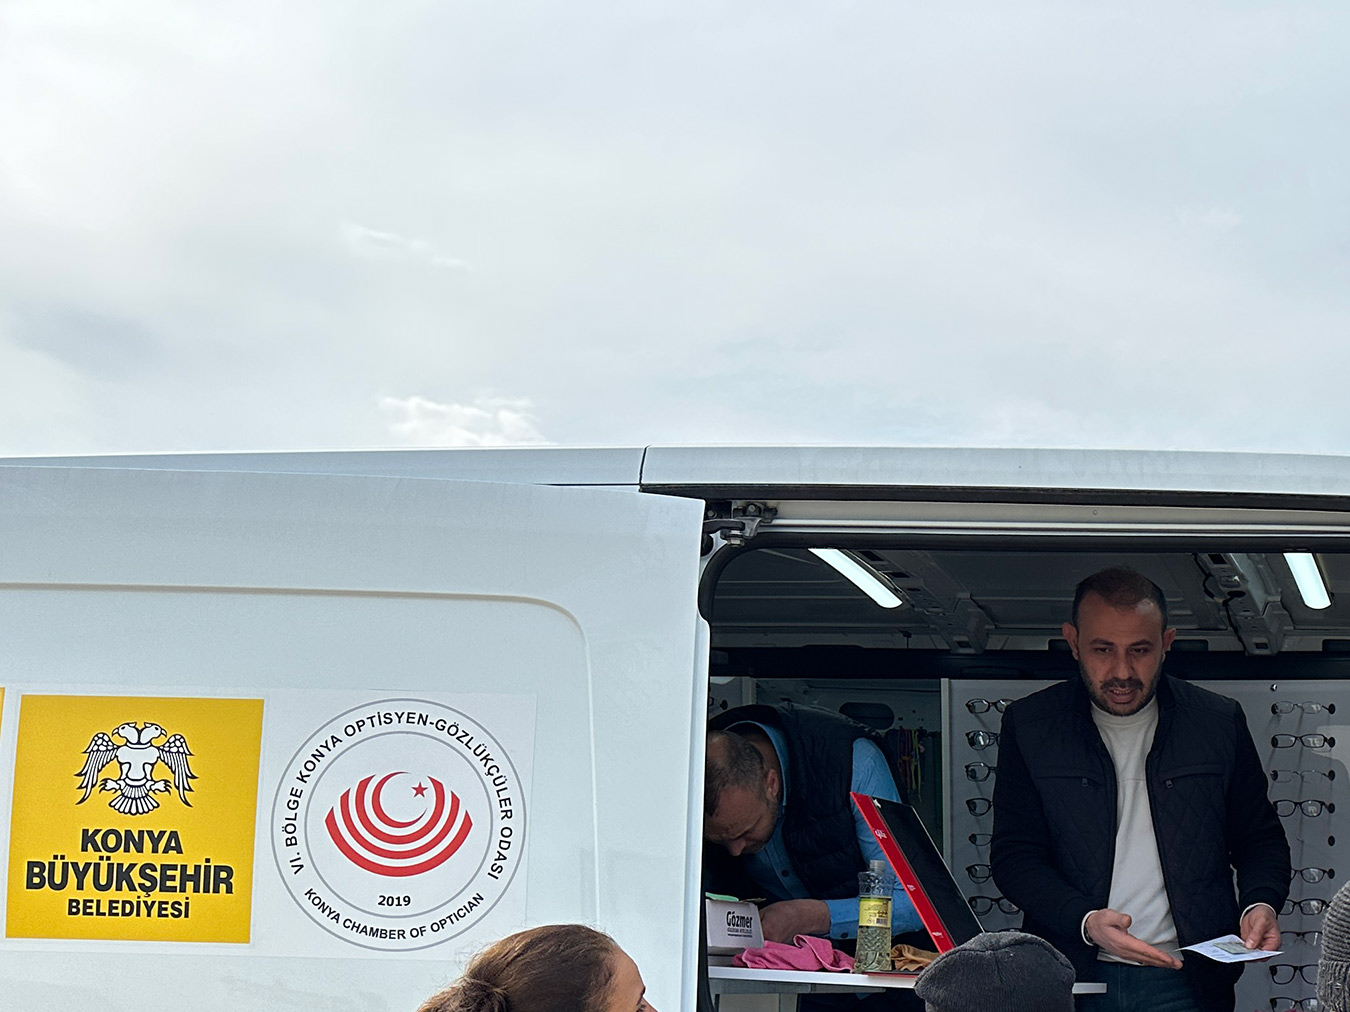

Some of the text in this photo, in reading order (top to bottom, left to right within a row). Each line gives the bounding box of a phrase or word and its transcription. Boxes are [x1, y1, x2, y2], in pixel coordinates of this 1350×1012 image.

[281, 711, 514, 880] VI. BÖLGE KONYA OPTİSYEN-GÖZLÜKÇÜLER ODASI
[80, 828, 184, 854] KONYA
[25, 854, 235, 897] BÜYÜKŞEHİR
[67, 896, 190, 919] BELEDİYESİ
[304, 888, 485, 940] KONYA CHAMBER OF OPTICIAN
[377, 895, 412, 907] 2019
